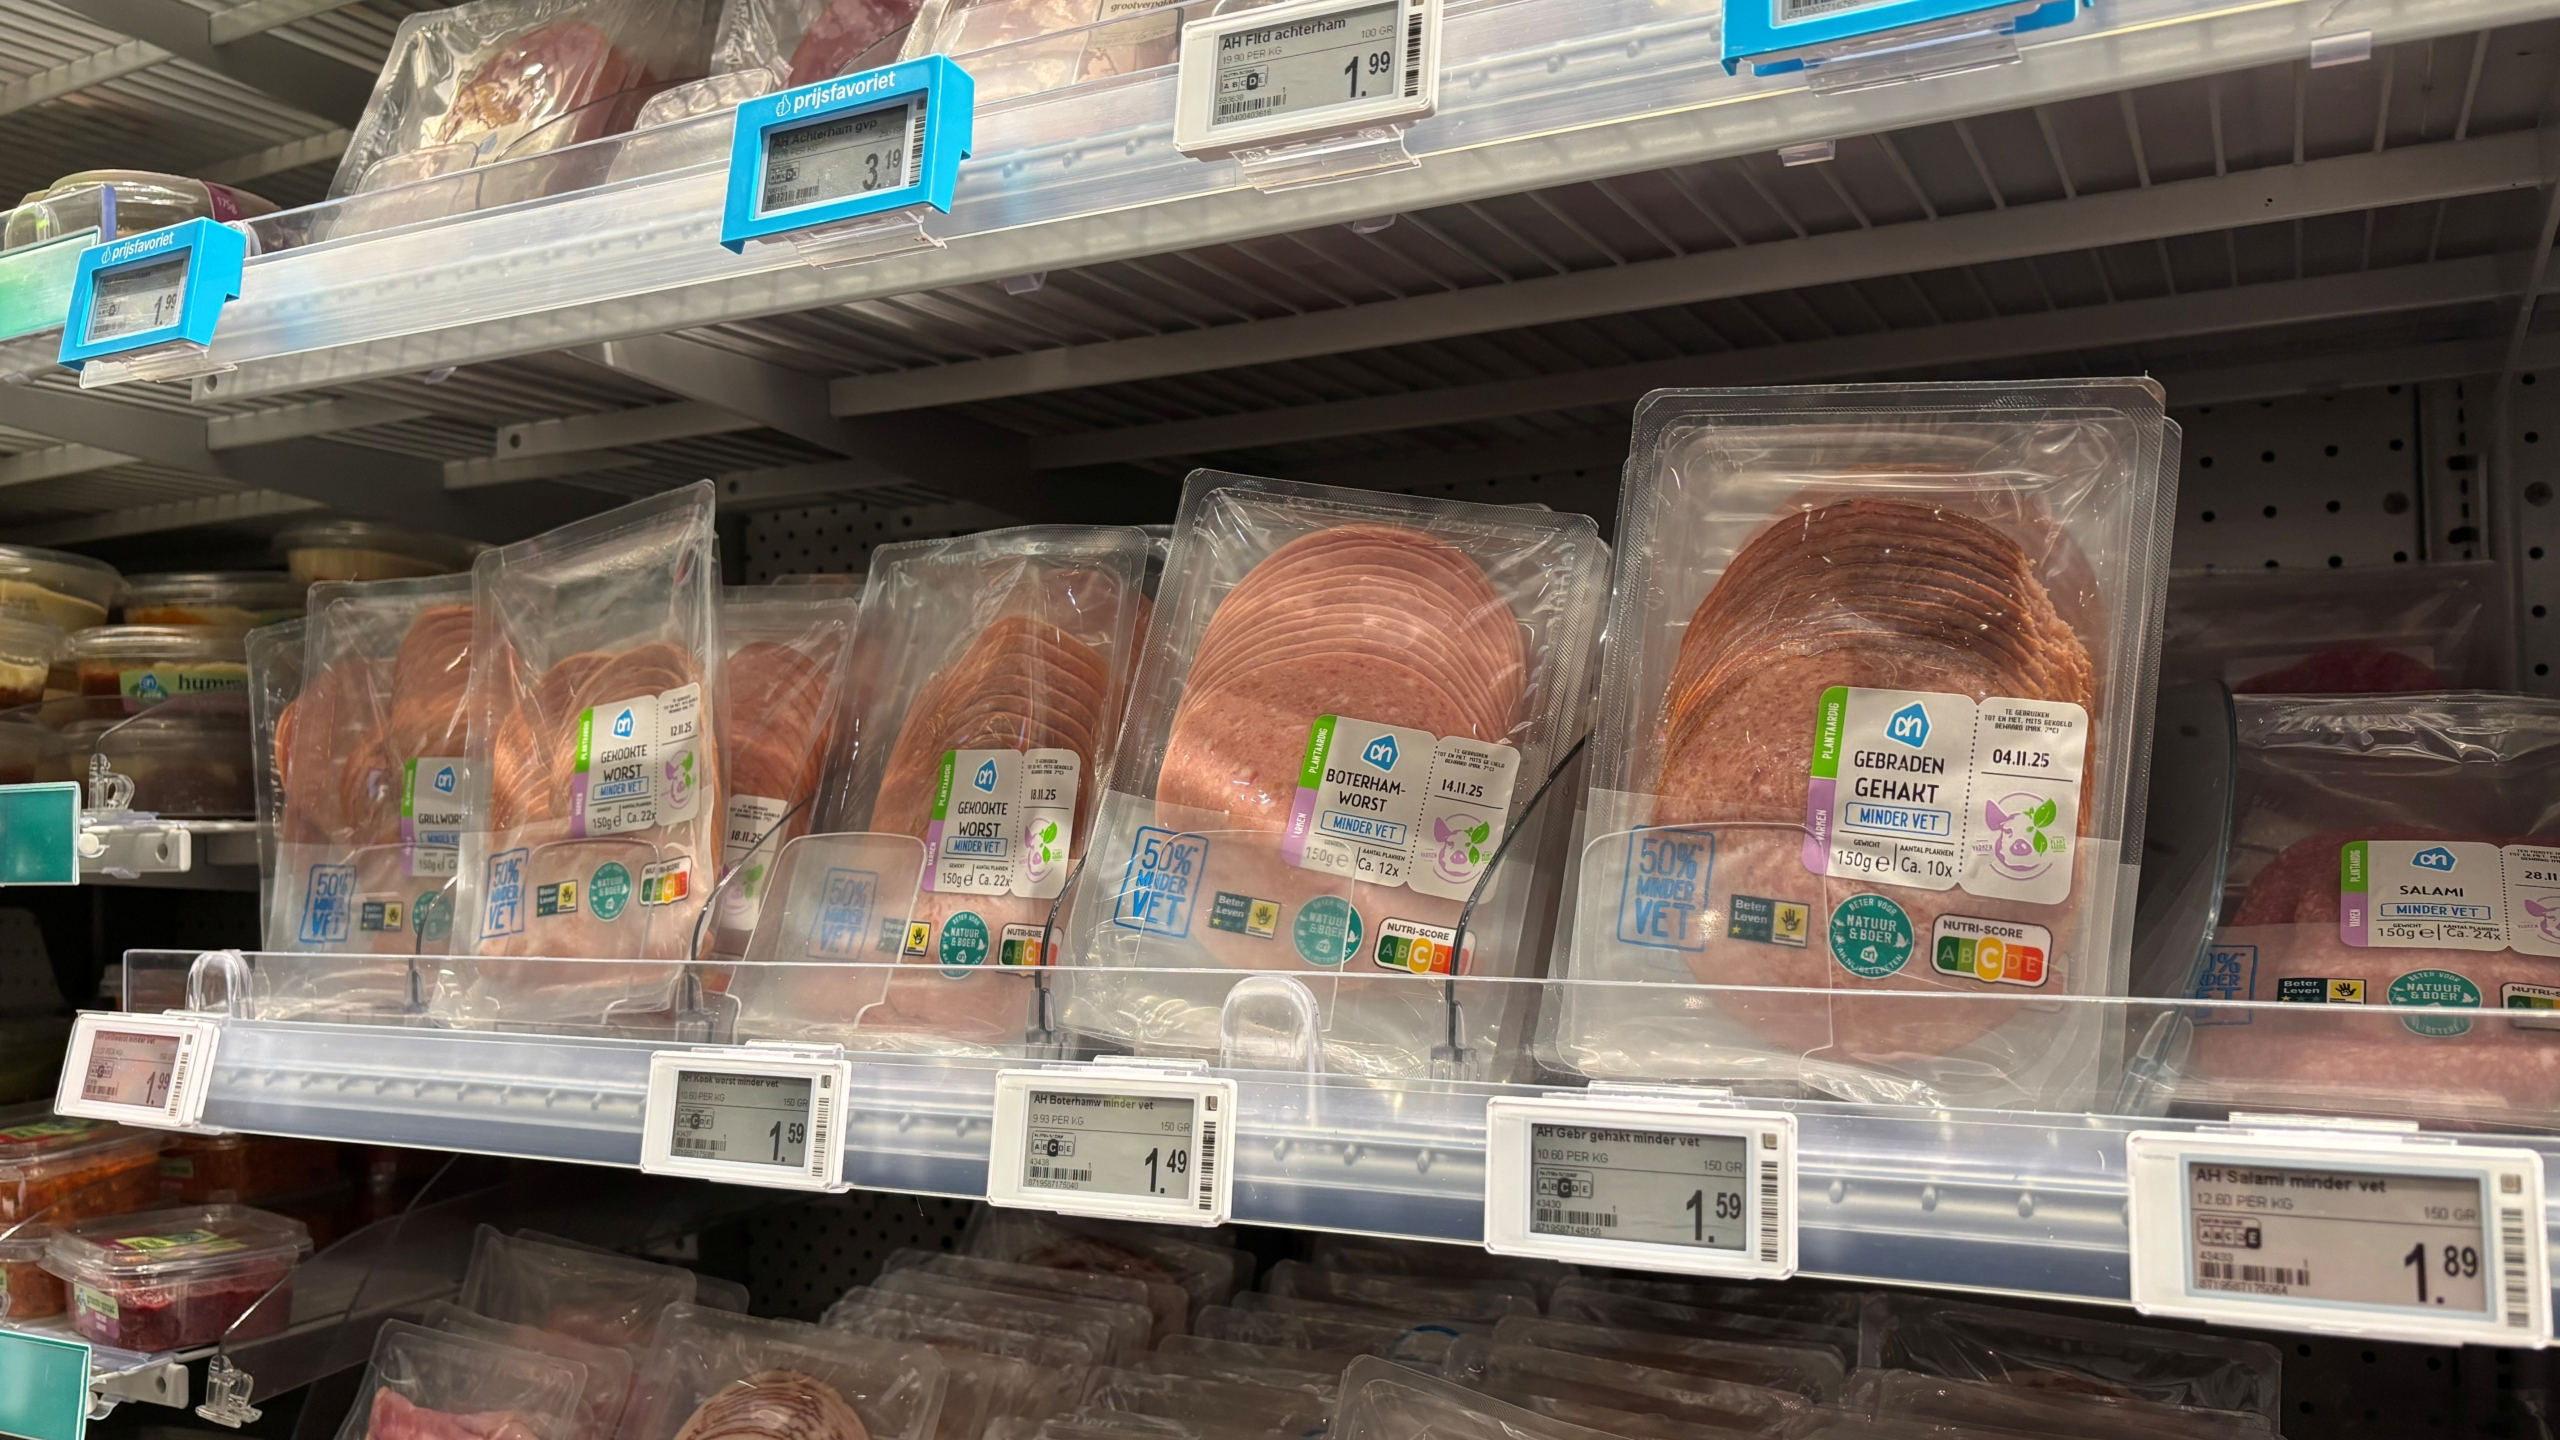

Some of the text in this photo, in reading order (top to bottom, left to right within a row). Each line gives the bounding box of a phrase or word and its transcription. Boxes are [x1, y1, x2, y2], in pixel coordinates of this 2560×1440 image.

[1222, 37, 1241, 50] AH
[1245, 31, 1270, 46] Fltd
[1275, 18, 1346, 40] achterham
[1361, 25, 1394, 38] 100 GR
[1247, 46, 1283, 61] PER KG
[793, 71, 896, 113] prijsfavoriet
[790, 119, 878, 143] Achterham gvp
[112, 231, 174, 262] prijsfavoriet
[2015, 710, 2049, 718] GEBRUIKEN
[670, 722, 692, 736] 12.11.25
[1822, 702, 1839, 760] PLANTAARDIG
[1995, 723, 2023, 731] BEWAARD
[2044, 720, 2073, 728] GEKOELD
[601, 744, 648, 763] GEKOOKTE
[1309, 728, 1328, 774] PLANTAARDIG
[1992, 748, 2050, 768] 04.11.25
[1854, 750, 1945, 775] GEBRADEN
[604, 764, 642, 782] WORST
[600, 780, 643, 796] MINDER VET
[939, 764, 951, 807] PLANTAARDIG
[1325, 768, 1407, 796] BOTERHAM-
[1442, 779, 1484, 797] 14.11.25
[1031, 789, 1056, 800] 18.11.25
[1855, 777, 1940, 804] GEHAKT
[958, 801, 1008, 816] GEKOOKTE
[1339, 790, 1387, 813] WORST
[593, 817, 612, 830] 150g
[627, 810, 656, 823] Ca. 22x
[1859, 807, 1940, 831] MINDER VET
[959, 821, 1001, 837] WORST
[1333, 816, 1398, 840] MINDER VET
[954, 840, 1001, 853] MINDER VET
[1854, 839, 1881, 849] GEWICHT
[1900, 845, 1954, 857] AANTAL PLAKKEN
[927, 842, 937, 867] VARKEN
[1305, 846, 1334, 867] 150g
[1362, 848, 1405, 862] AANTAL PLAKKEN
[1837, 850, 1871, 873] 150g
[1357, 857, 1399, 878] Ca. 12x
[1901, 857, 1953, 878] Ca. 10x
[942, 872, 962, 888] 150g
[978, 872, 1010, 887] Ca. 22x
[1136, 869, 1188, 895] MINDER
[1636, 875, 1695, 903] MINDER
[2400, 885, 2464, 898] SALAMI
[1132, 889, 1186, 926] VET
[1219, 895, 1246, 907] Beter
[1735, 899, 1767, 912] Beter
[1848, 897, 1898, 916] BETER VOOR
[489, 901, 517, 931] VET
[1216, 905, 1245, 918] Leven
[1635, 897, 1696, 940] VET
[1734, 911, 1767, 924] Leven
[2396, 905, 2479, 918] MINDER VET
[1387, 922, 1449, 940] NUTRI-SCORE
[1846, 915, 1897, 932] NATUUR
[1943, 920, 2024, 939] NUTRI-SCORE
[951, 927, 979, 938] NATUUR
[1007, 928, 1042, 938] NUTRI-SCORE
[1318, 926, 1345, 939] BOER
[1849, 929, 1892, 944] & BOER
[2377, 927, 2415, 940] 150g
[2447, 928, 2502, 941] Ca. 24x
[957, 939, 976, 947] BOER
[2408, 971, 2461, 983] BETER VOOR
[2406, 983, 2461, 993] NATUUR
[2423, 992, 2458, 1001] BOER
[695, 1075, 713, 1083] Kook
[715, 1076, 736, 1085] worst
[737, 1077, 764, 1087] minder
[699, 1092, 725, 1101] PER KG
[783, 1098, 808, 1107] 150 GR
[1033, 1095, 1154, 1110] AH Boterhamw minder vet
[1052, 1115, 1084, 1125] PER KG
[1160, 1122, 1190, 1133] 150 GR
[770, 1121, 804, 1163] 1.59
[1536, 1126, 1700, 1148] AH Gebr gehakt minder vet
[1029, 1158, 1050, 1166] 43438
[1537, 1149, 1609, 1164] 10.60 PER KG
[1145, 1147, 1187, 1194] 1.49
[1703, 1160, 1743, 1172] 150 GR
[1028, 1179, 1079, 1189] 8719587175040
[2197, 1168, 2387, 1194] AH Salami minder vet
[1536, 1200, 1562, 1208] 43430
[2236, 1195, 2294, 1210] PER KG
[1686, 1189, 1742, 1243] 1.59
[2424, 1207, 2476, 1222] 150 GR
[1535, 1223, 1601, 1236] 8719587148150
[2404, 1242, 2479, 1305] 1.89
